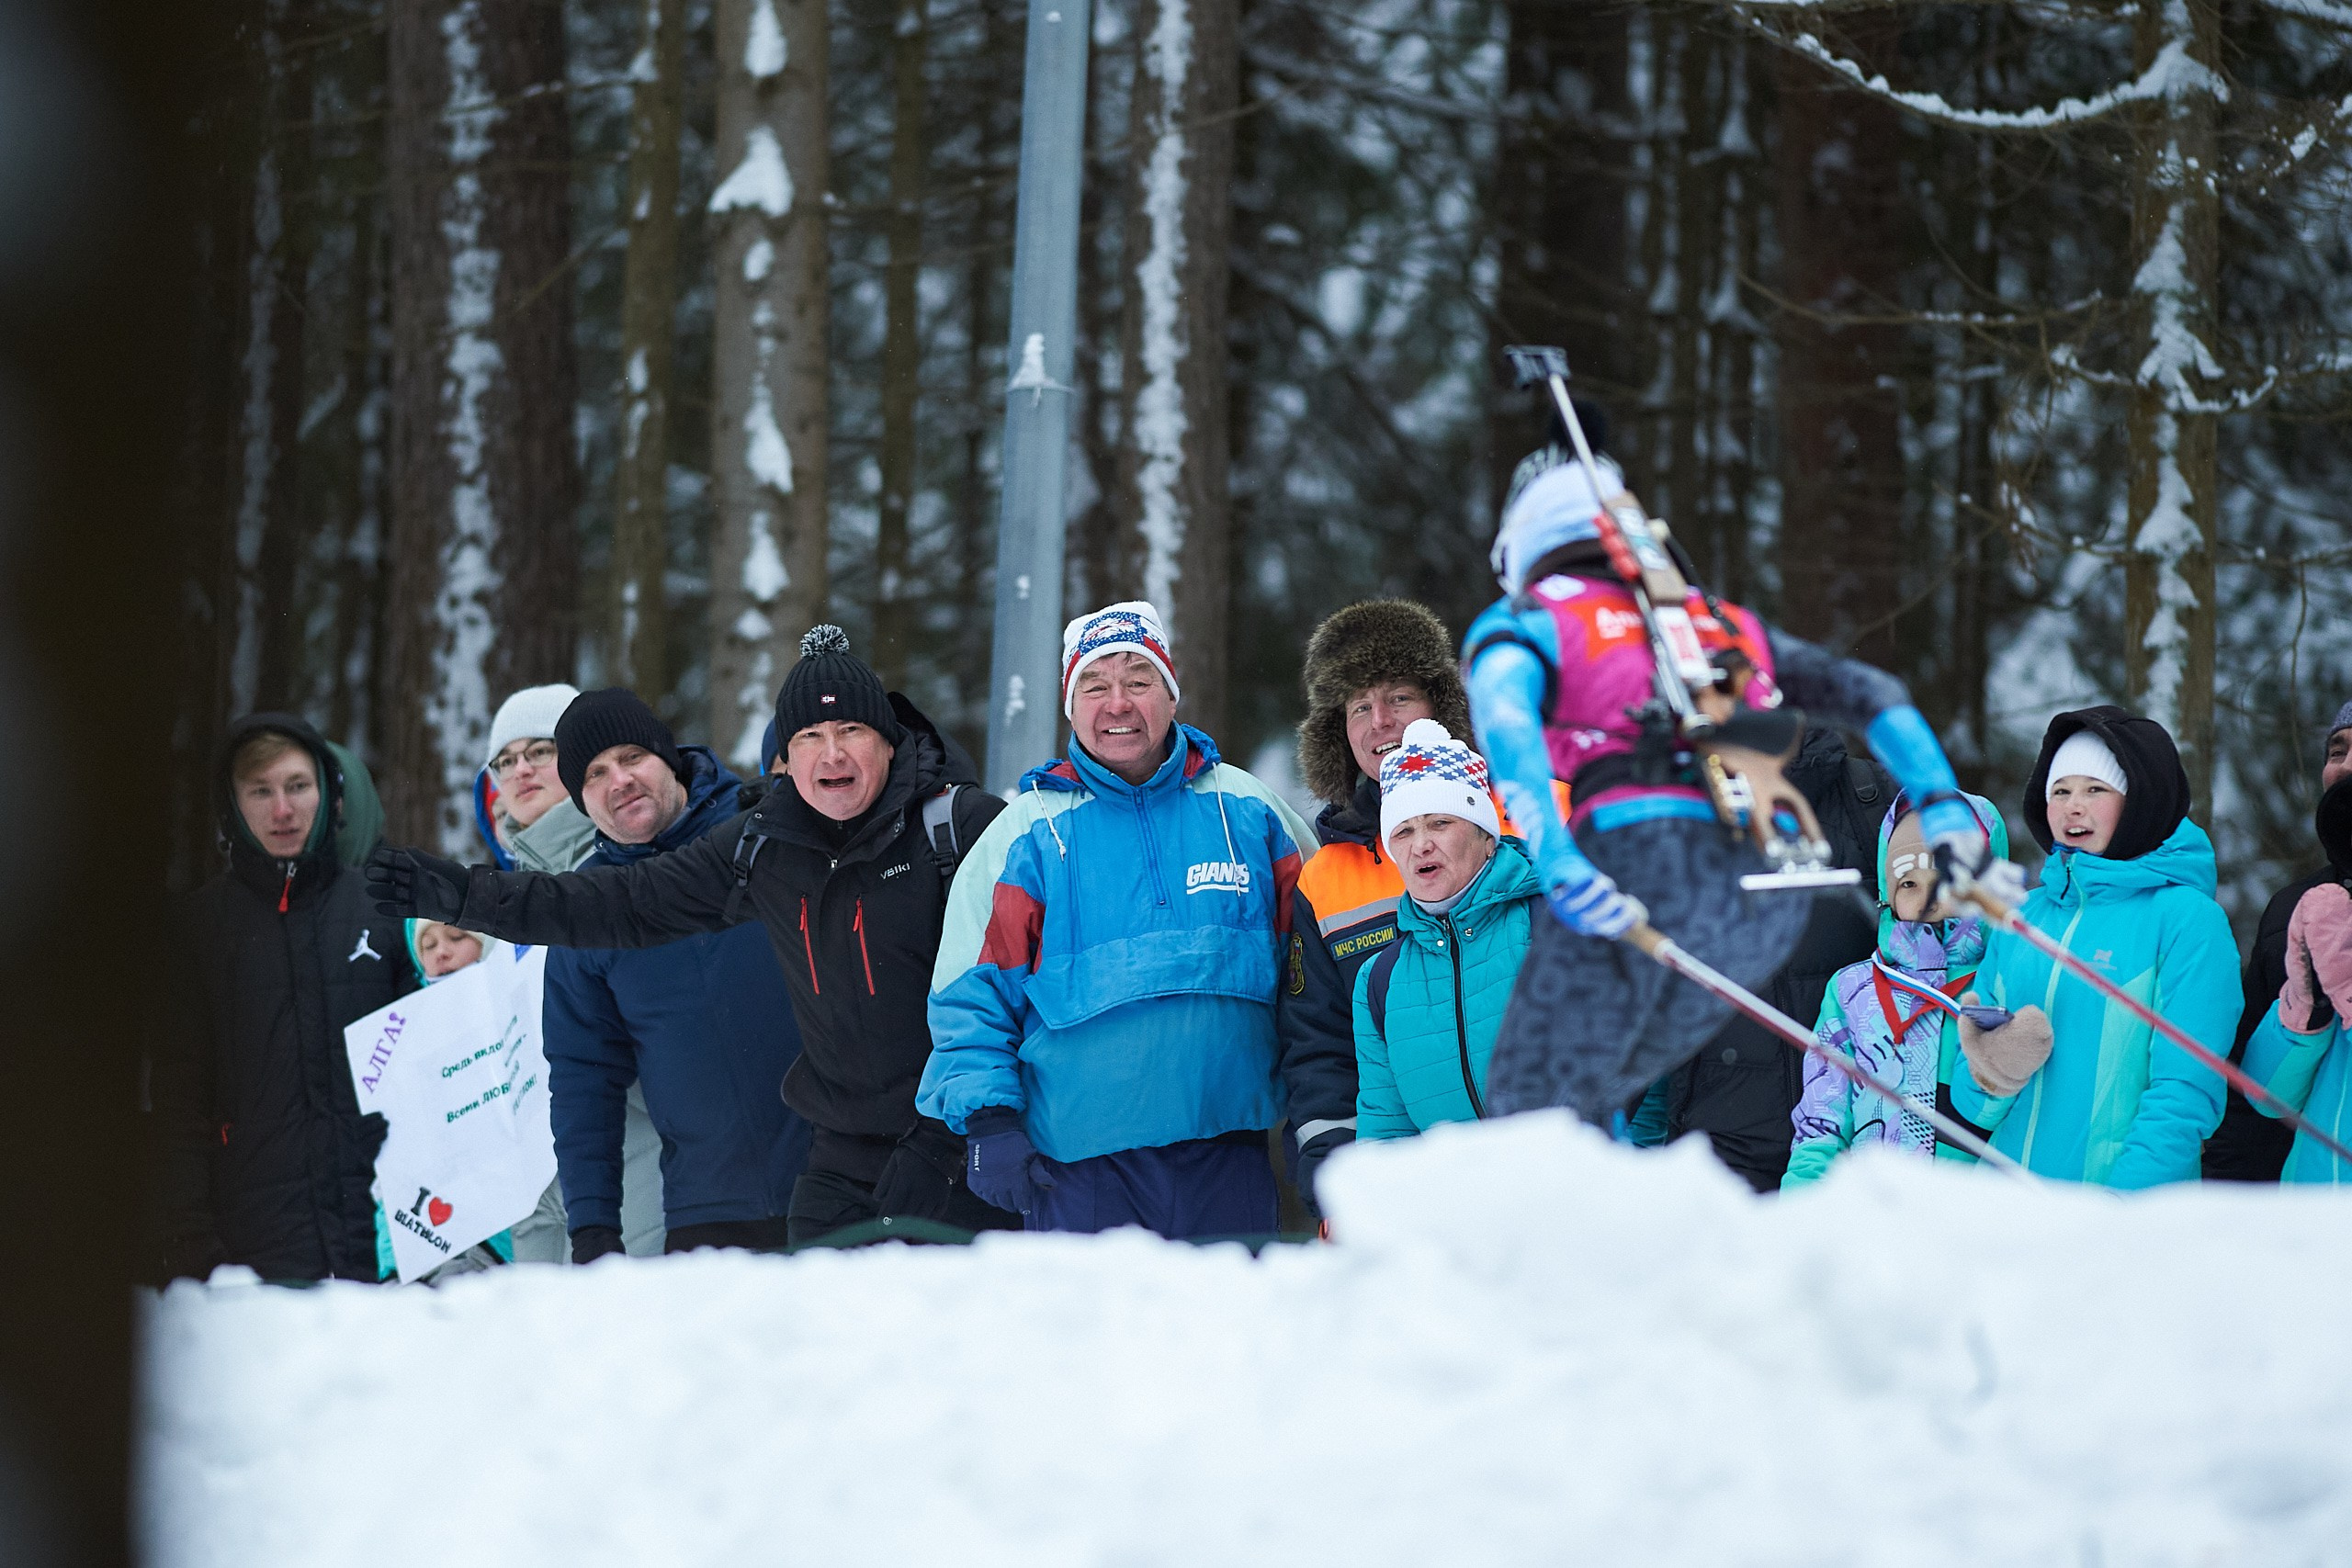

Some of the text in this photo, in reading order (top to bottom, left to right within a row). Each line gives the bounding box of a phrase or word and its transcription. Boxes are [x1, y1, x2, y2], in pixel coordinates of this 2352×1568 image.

[1186, 862, 1250, 887] GIANTS
[1893, 852, 1936, 879] FI
[1335, 927, 1395, 957] МЧС РОССИИ
[362, 1012, 406, 1094] АЛГА!
[442, 1056, 473, 1078] Средь
[474, 1039, 504, 1060] видо
[447, 1100, 480, 1122] Всеми
[411, 1186, 431, 1216] I
